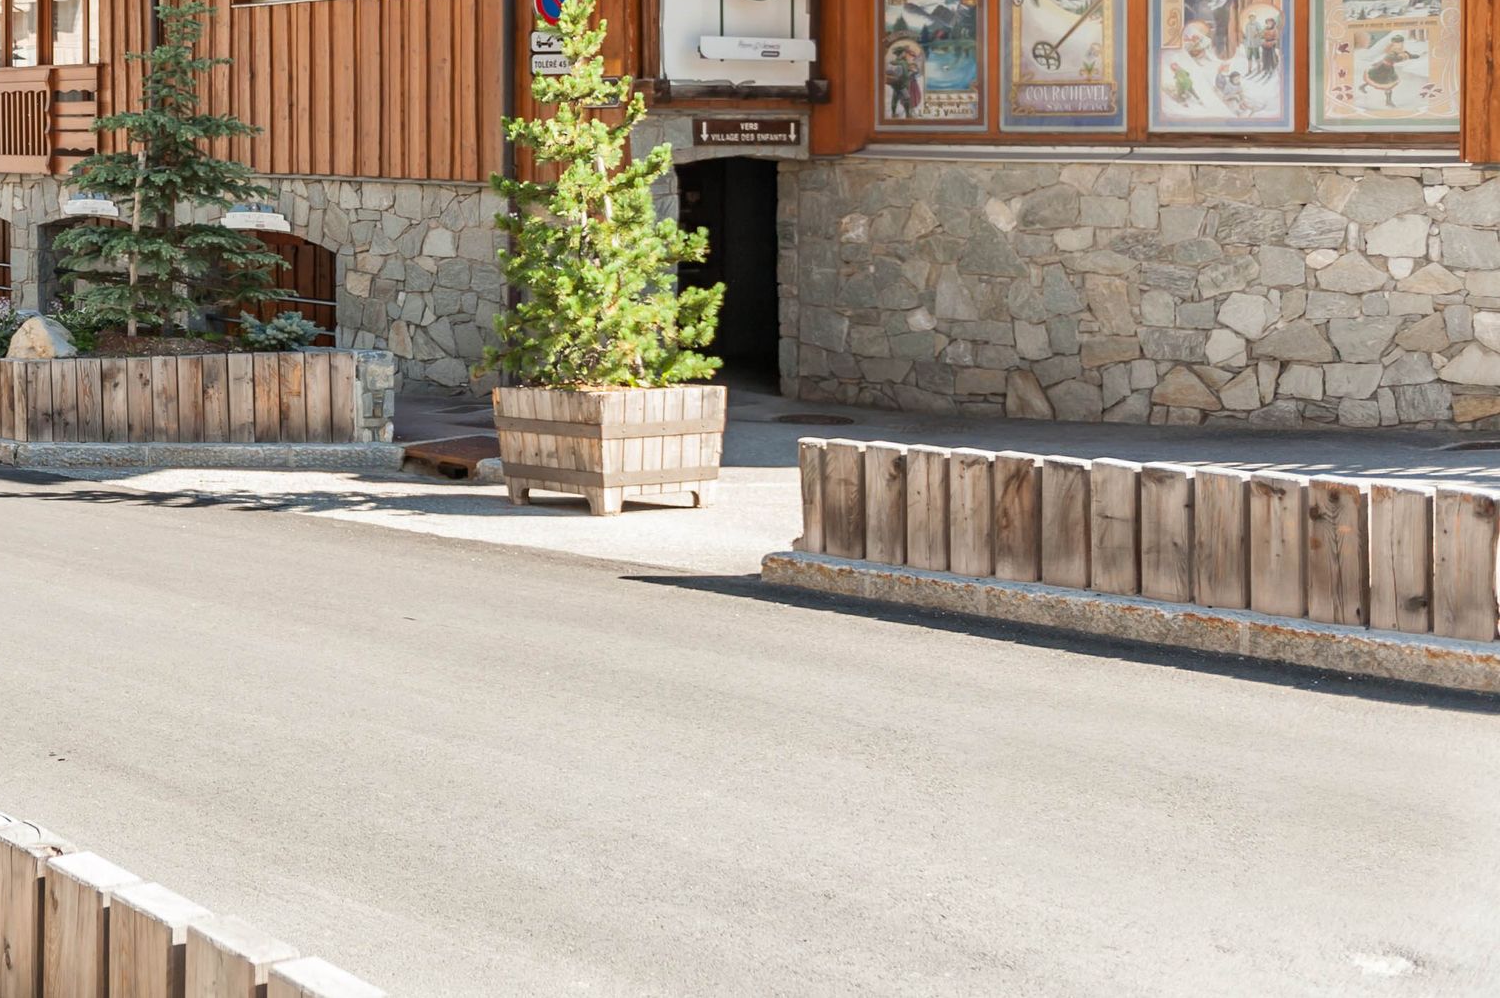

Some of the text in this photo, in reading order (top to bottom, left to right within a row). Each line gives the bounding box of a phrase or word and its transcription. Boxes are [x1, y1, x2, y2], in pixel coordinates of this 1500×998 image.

[534, 59, 557, 69] TOLÉRÉ
[558, 60, 567, 69] 45
[1026, 85, 1109, 101] COURCHEVEL
[740, 122, 759, 131] VERS
[710, 133, 788, 142] VILLAGE DES ENFANTS
